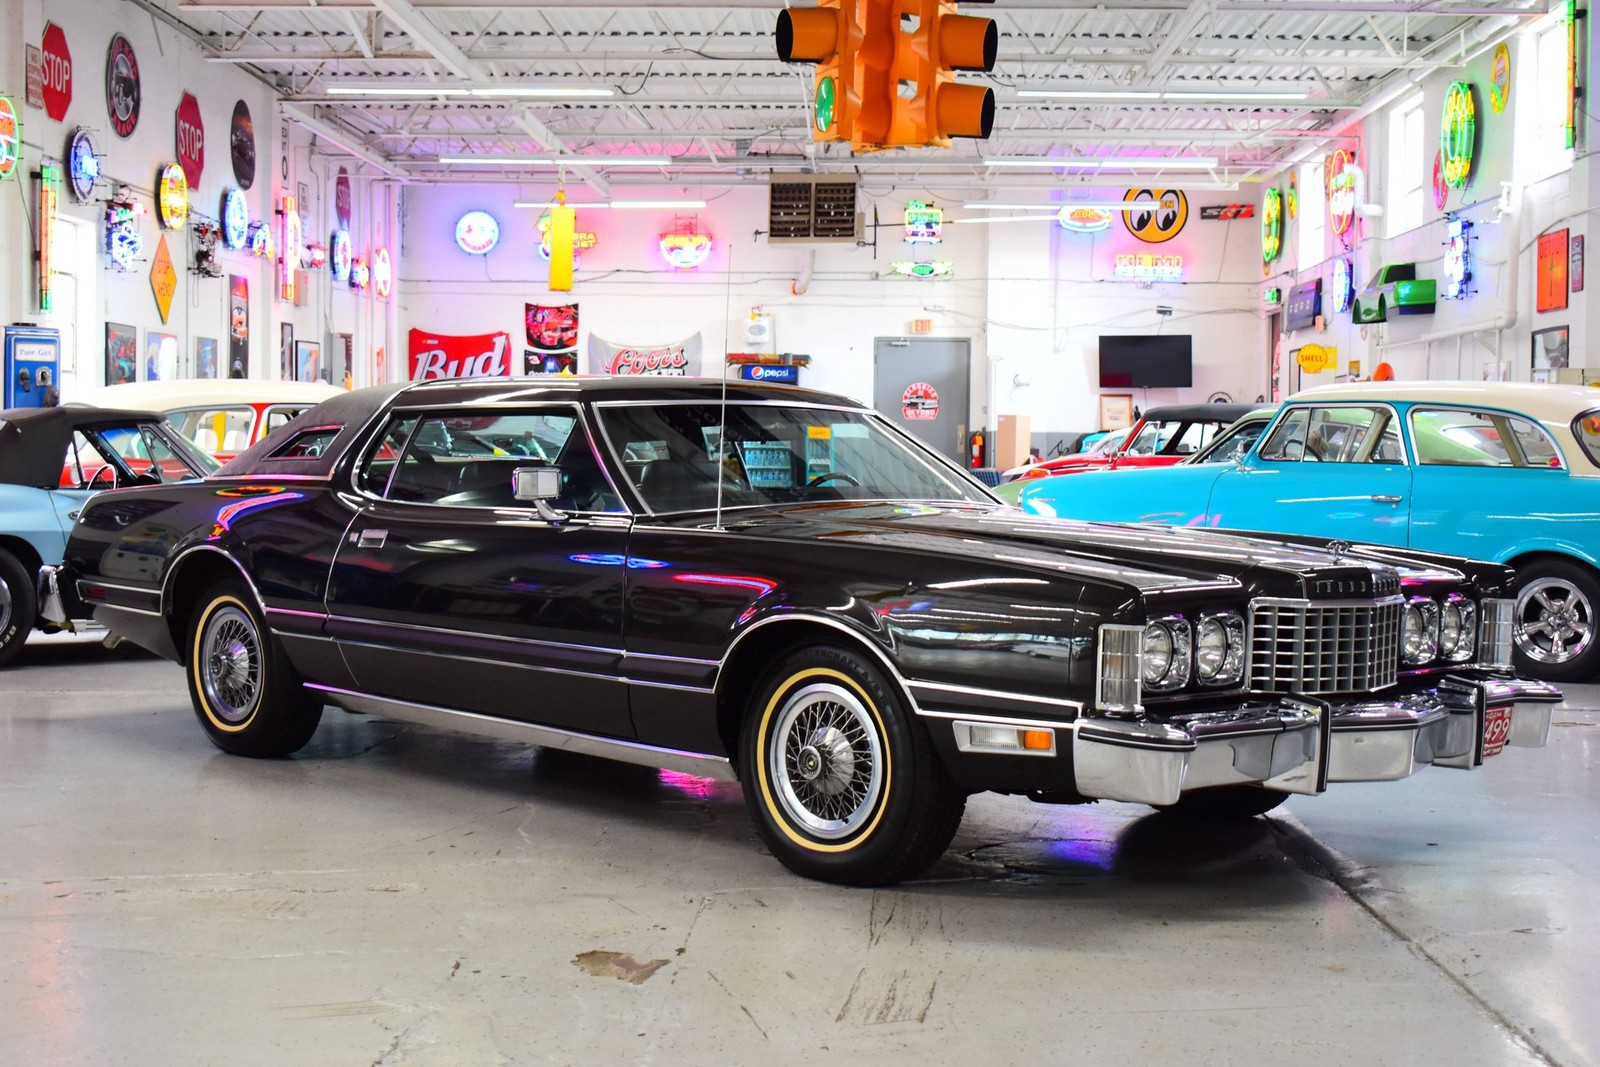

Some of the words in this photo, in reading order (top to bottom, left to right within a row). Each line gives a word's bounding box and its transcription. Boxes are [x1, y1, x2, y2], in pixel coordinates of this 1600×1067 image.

[42, 50, 70, 94] STOP
[180, 119, 203, 162] STOP
[338, 184, 351, 210] STOP
[915, 319, 932, 333] EXIT
[19, 348, 36, 356] Pure
[37, 348, 52, 357] Gas
[413, 335, 506, 380] Bud
[528, 355, 541, 365] 3
[603, 345, 688, 375] Coors
[1300, 354, 1323, 362] SHELL
[764, 368, 789, 379] pepsi
[1485, 718, 1510, 742] 499
